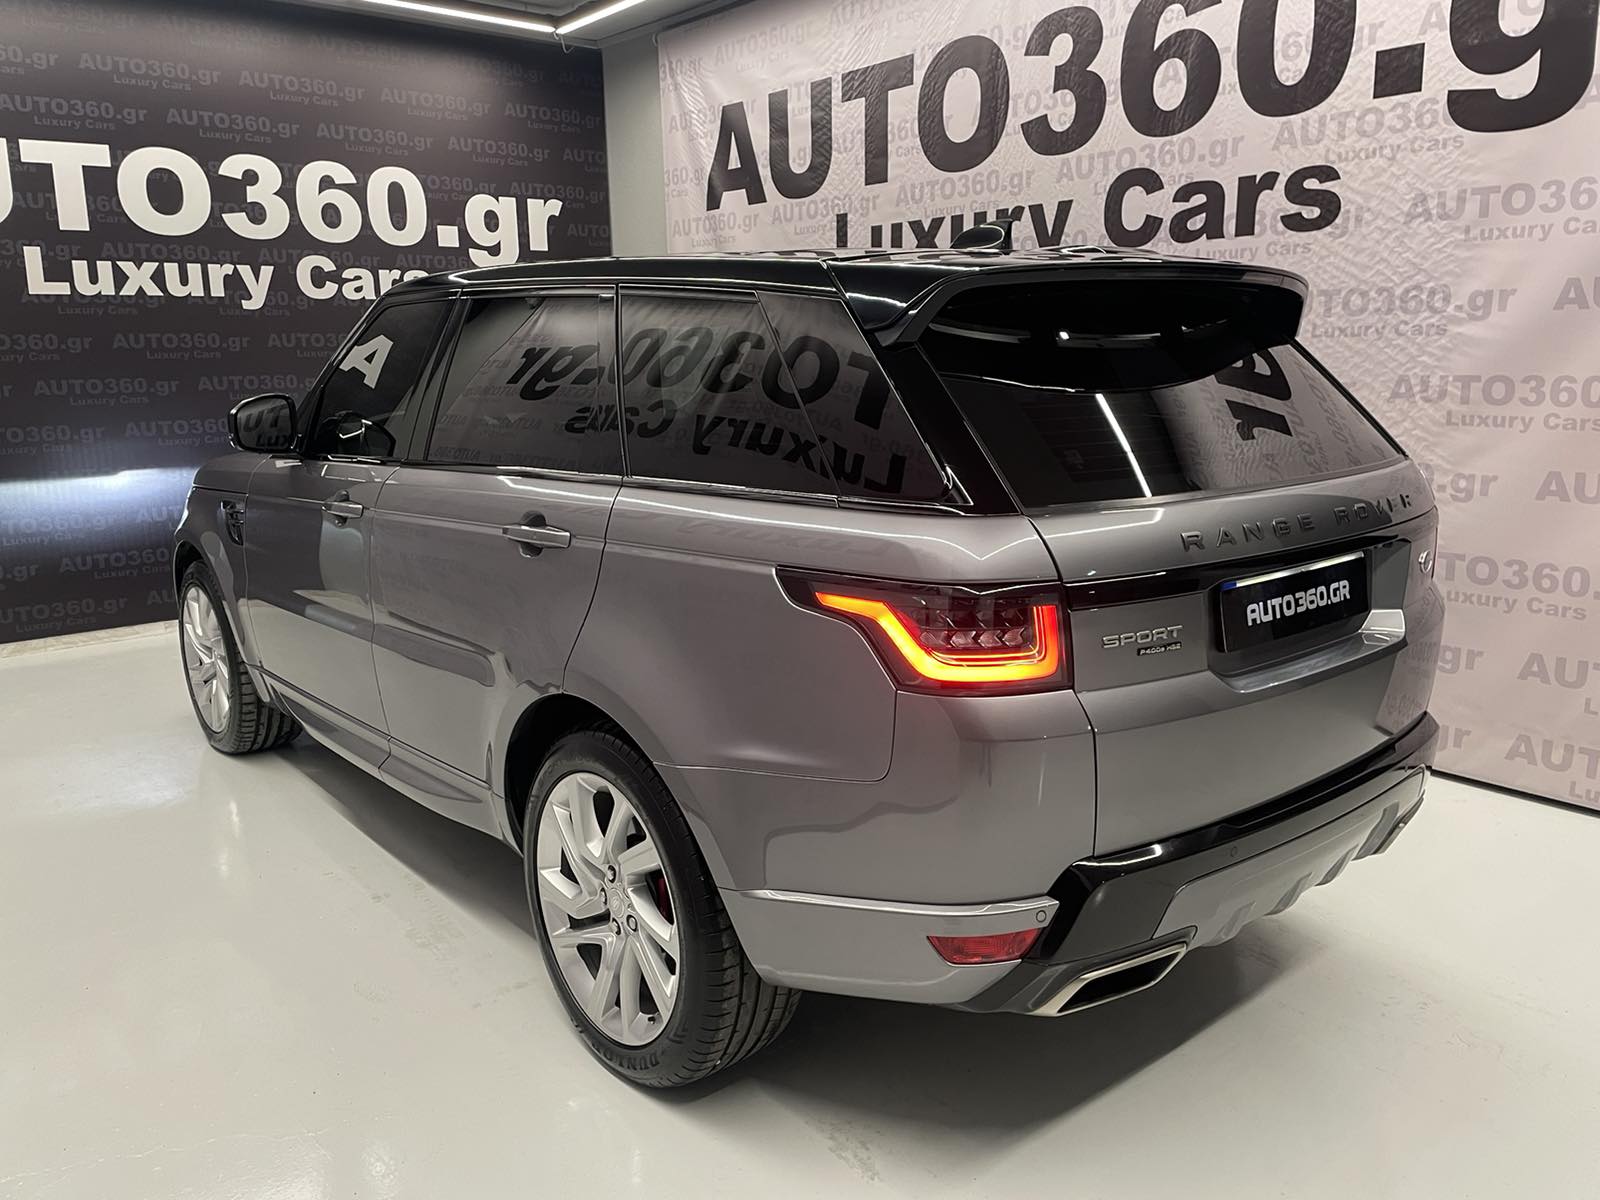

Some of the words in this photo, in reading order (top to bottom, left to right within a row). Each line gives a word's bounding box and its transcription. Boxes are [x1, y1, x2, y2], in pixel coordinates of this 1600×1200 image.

[78, 53, 221, 86] AUTO360.gr
[238, 70, 366, 102] AUTO360.gr
[0, 93, 148, 125] AUTO360.gr
[380, 87, 491, 117] AUTO360.gr
[166, 108, 300, 138] AUTO360.gr
[316, 122, 433, 151] AUTO360.gr
[1272, 97, 1452, 153] AUTO36
[447, 136, 551, 162] AUTO360.gr
[1055, 134, 1245, 184] AUTO360.gr
[1409, 134, 1465, 155] Cars
[0, 137, 563, 267] TO360.gr
[895, 168, 1036, 208] AUTO360.gr
[1104, 164, 1342, 248] Cars
[1463, 222, 1555, 243] Luxury
[23, 245, 274, 309] Luxury
[1308, 282, 1518, 321] TO360.gr
[112, 332, 251, 352] AUTO360.gr
[1394, 319, 1450, 338] Cars
[34, 377, 181, 397] AUTO360.gr
[198, 374, 315, 392] AUTO360.g
[1445, 409, 1535, 434] Luxury
[1180, 512, 1316, 552] RANGE
[1247, 579, 1351, 627] AUTO360.GR
[1442, 589, 1519, 614] uxury
[1526, 596, 1588, 620] Cars
[1102, 624, 1183, 649] SPORT
